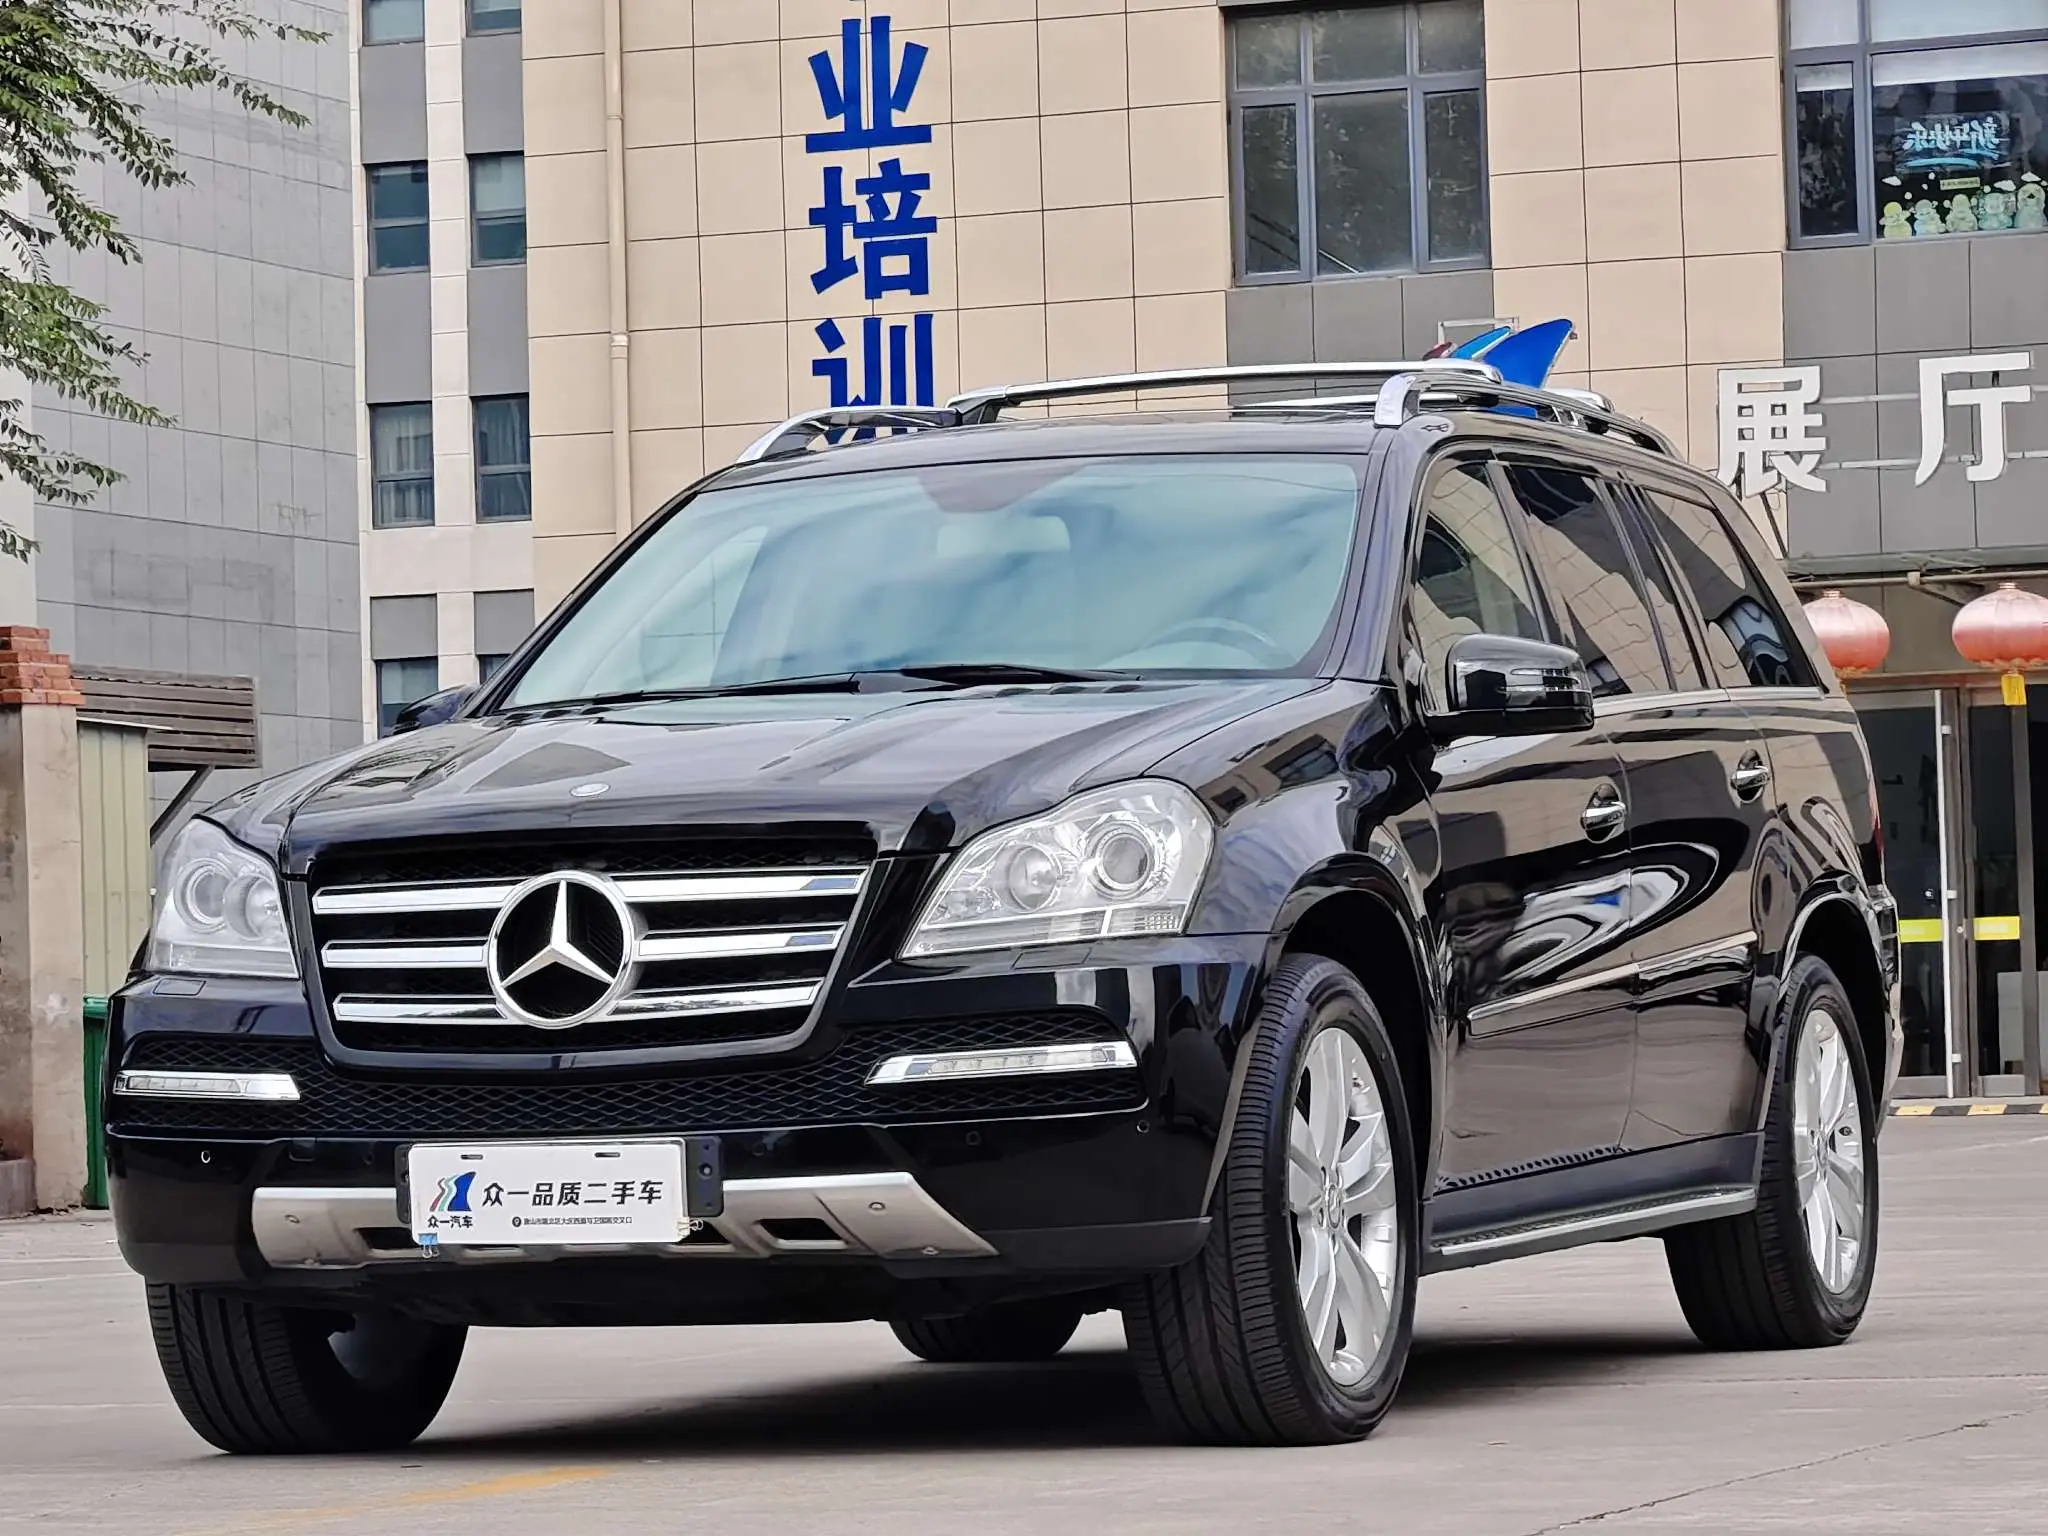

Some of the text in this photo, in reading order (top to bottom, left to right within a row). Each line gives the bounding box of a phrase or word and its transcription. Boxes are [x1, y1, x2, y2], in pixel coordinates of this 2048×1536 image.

[805, 15, 937, 448] 业培训
[1716, 351, 2031, 498] 展厅
[427, 1215, 473, 1229] 众一汽车
[482, 1180, 664, 1207] 众一品质二手车
